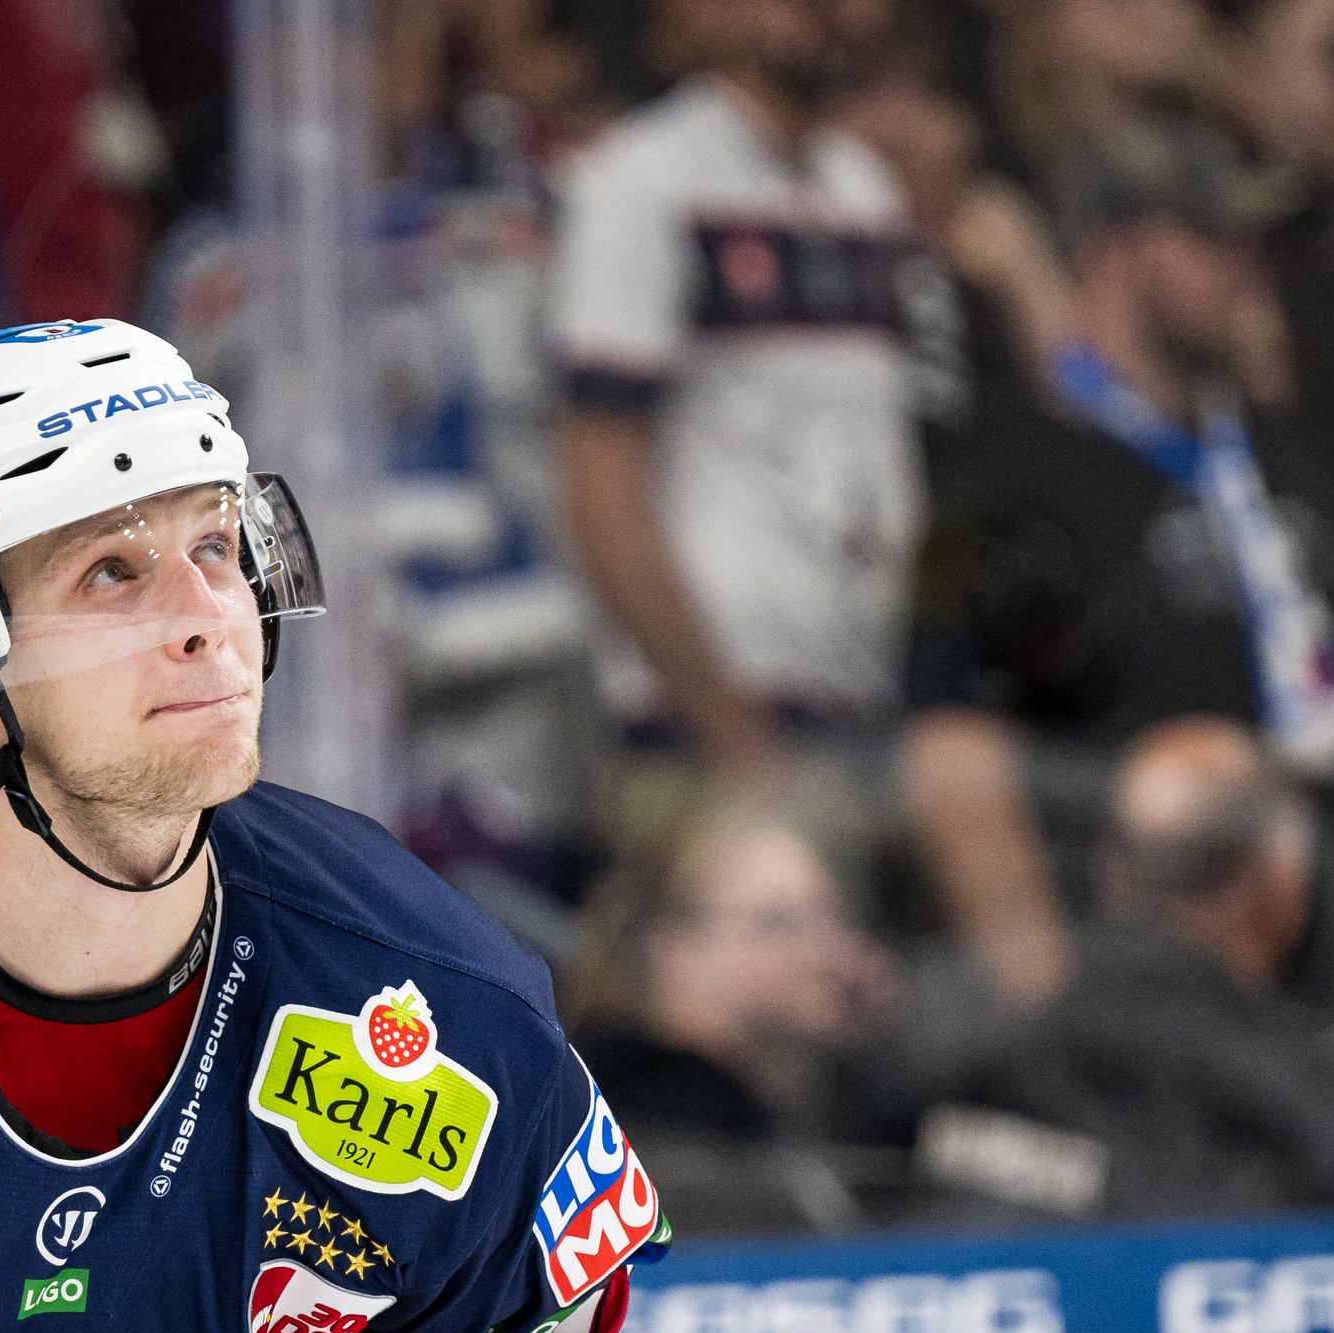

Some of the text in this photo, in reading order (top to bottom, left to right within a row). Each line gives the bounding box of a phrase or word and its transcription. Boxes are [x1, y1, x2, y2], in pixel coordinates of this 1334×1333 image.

[36, 380, 223, 439] STADLER
[159, 960, 246, 1174] flash-security
[273, 1036, 468, 1173] Karls
[336, 1137, 376, 1170] 1921
[556, 1155, 654, 1292] MO
[23, 1278, 84, 1312] LIGO
